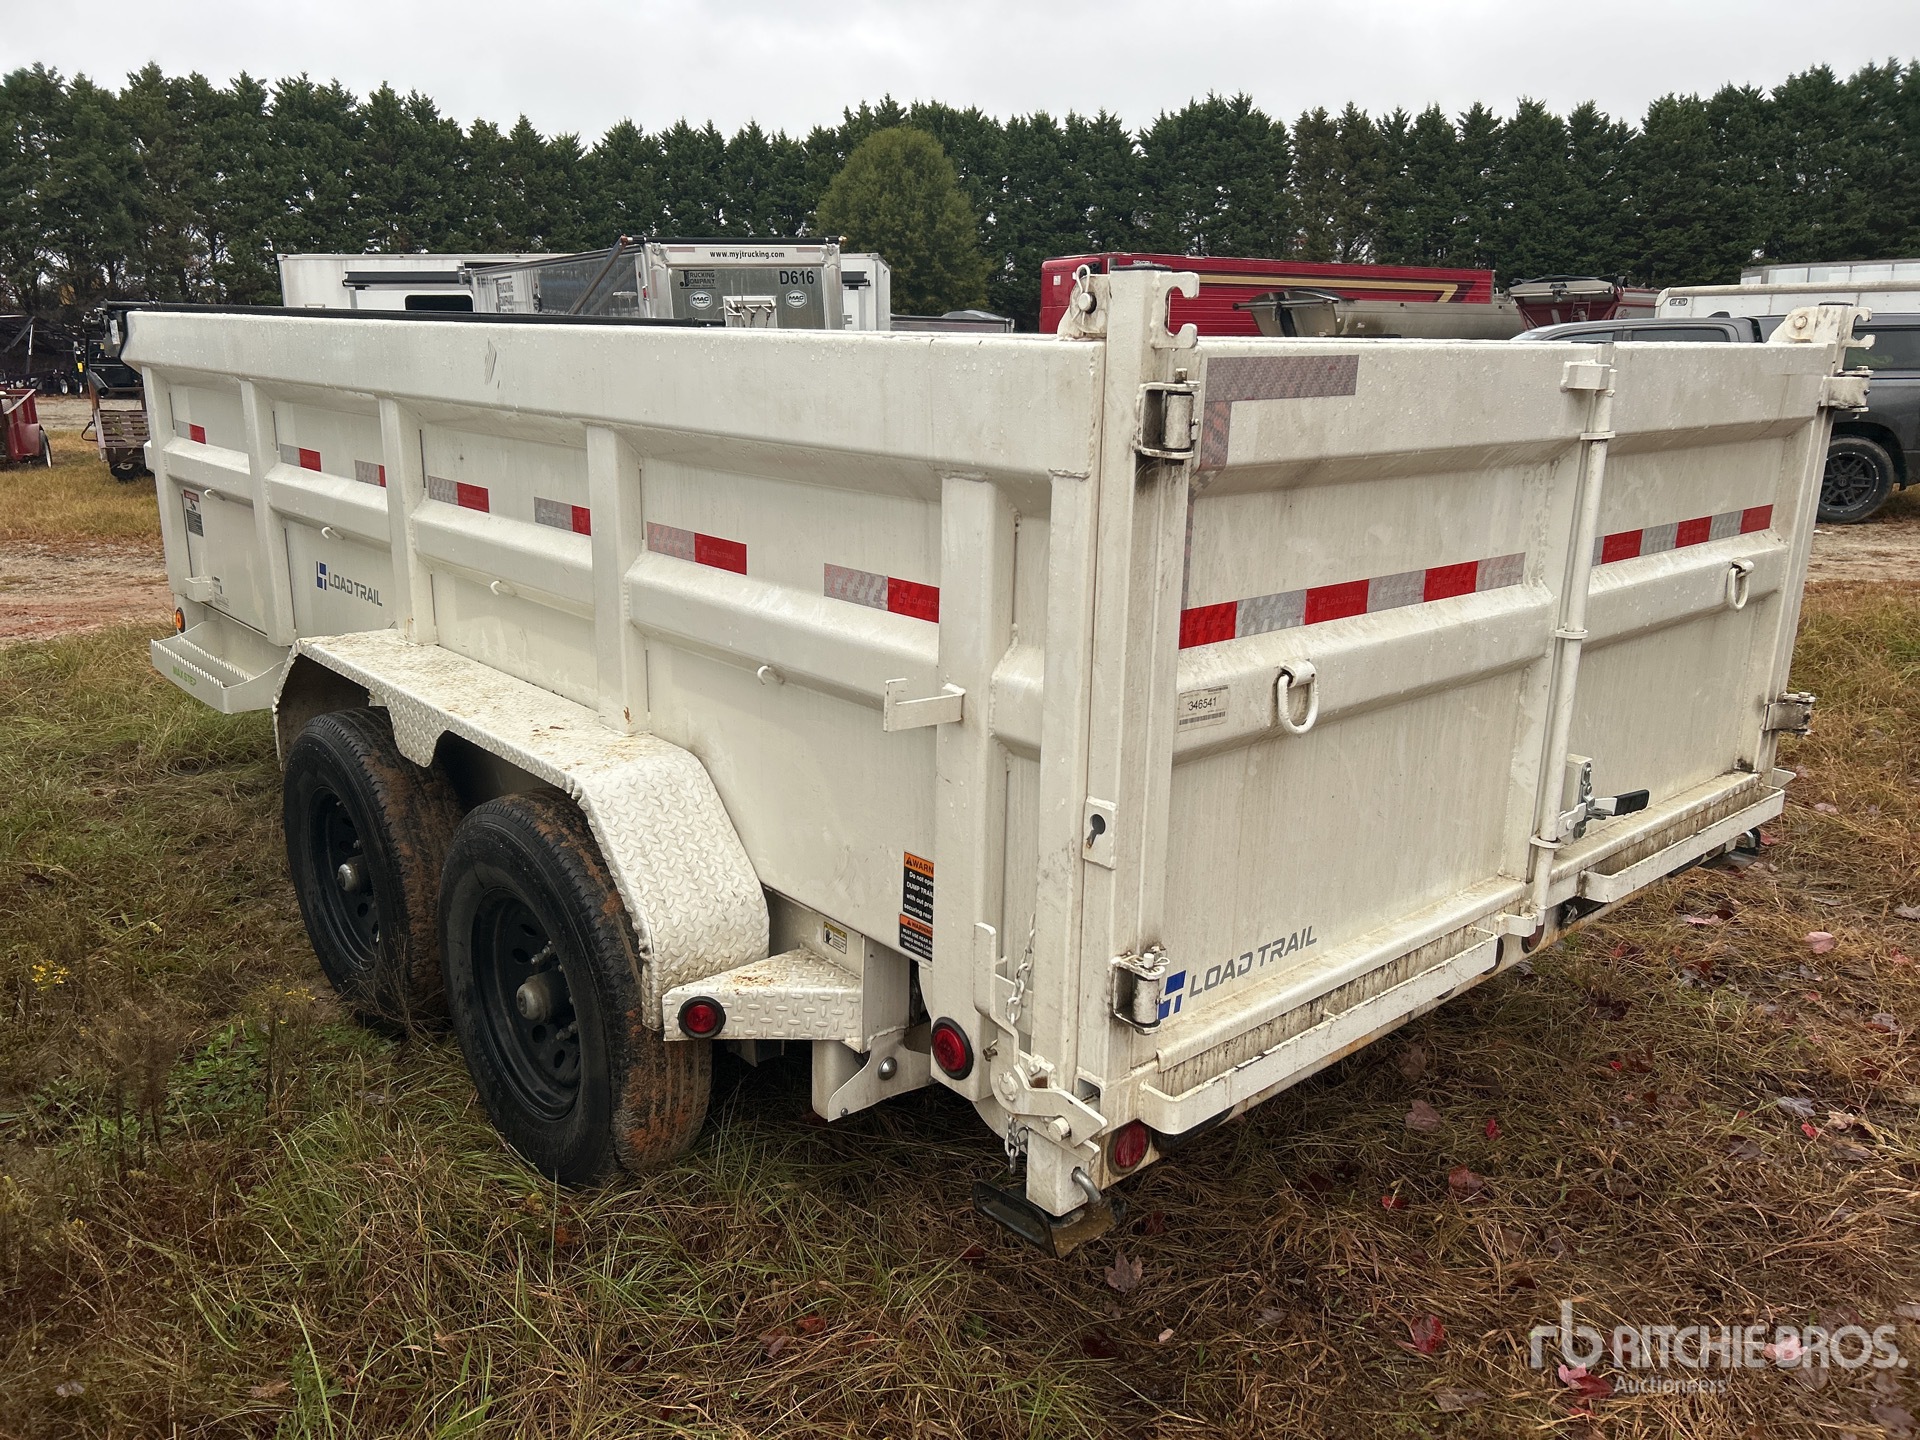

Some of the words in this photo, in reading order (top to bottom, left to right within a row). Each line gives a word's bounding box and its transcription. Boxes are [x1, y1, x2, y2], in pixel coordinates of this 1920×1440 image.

[710, 251, 785, 259] www.myjtrucking.com
[779, 270, 815, 285] D616
[328, 571, 353, 594] LOAD
[354, 581, 383, 606] TRAIL
[1188, 696, 1217, 711] 346541
[906, 881, 920, 891] DUMP
[1189, 951, 1253, 998] LOAD
[1257, 925, 1317, 967] TRAIL
